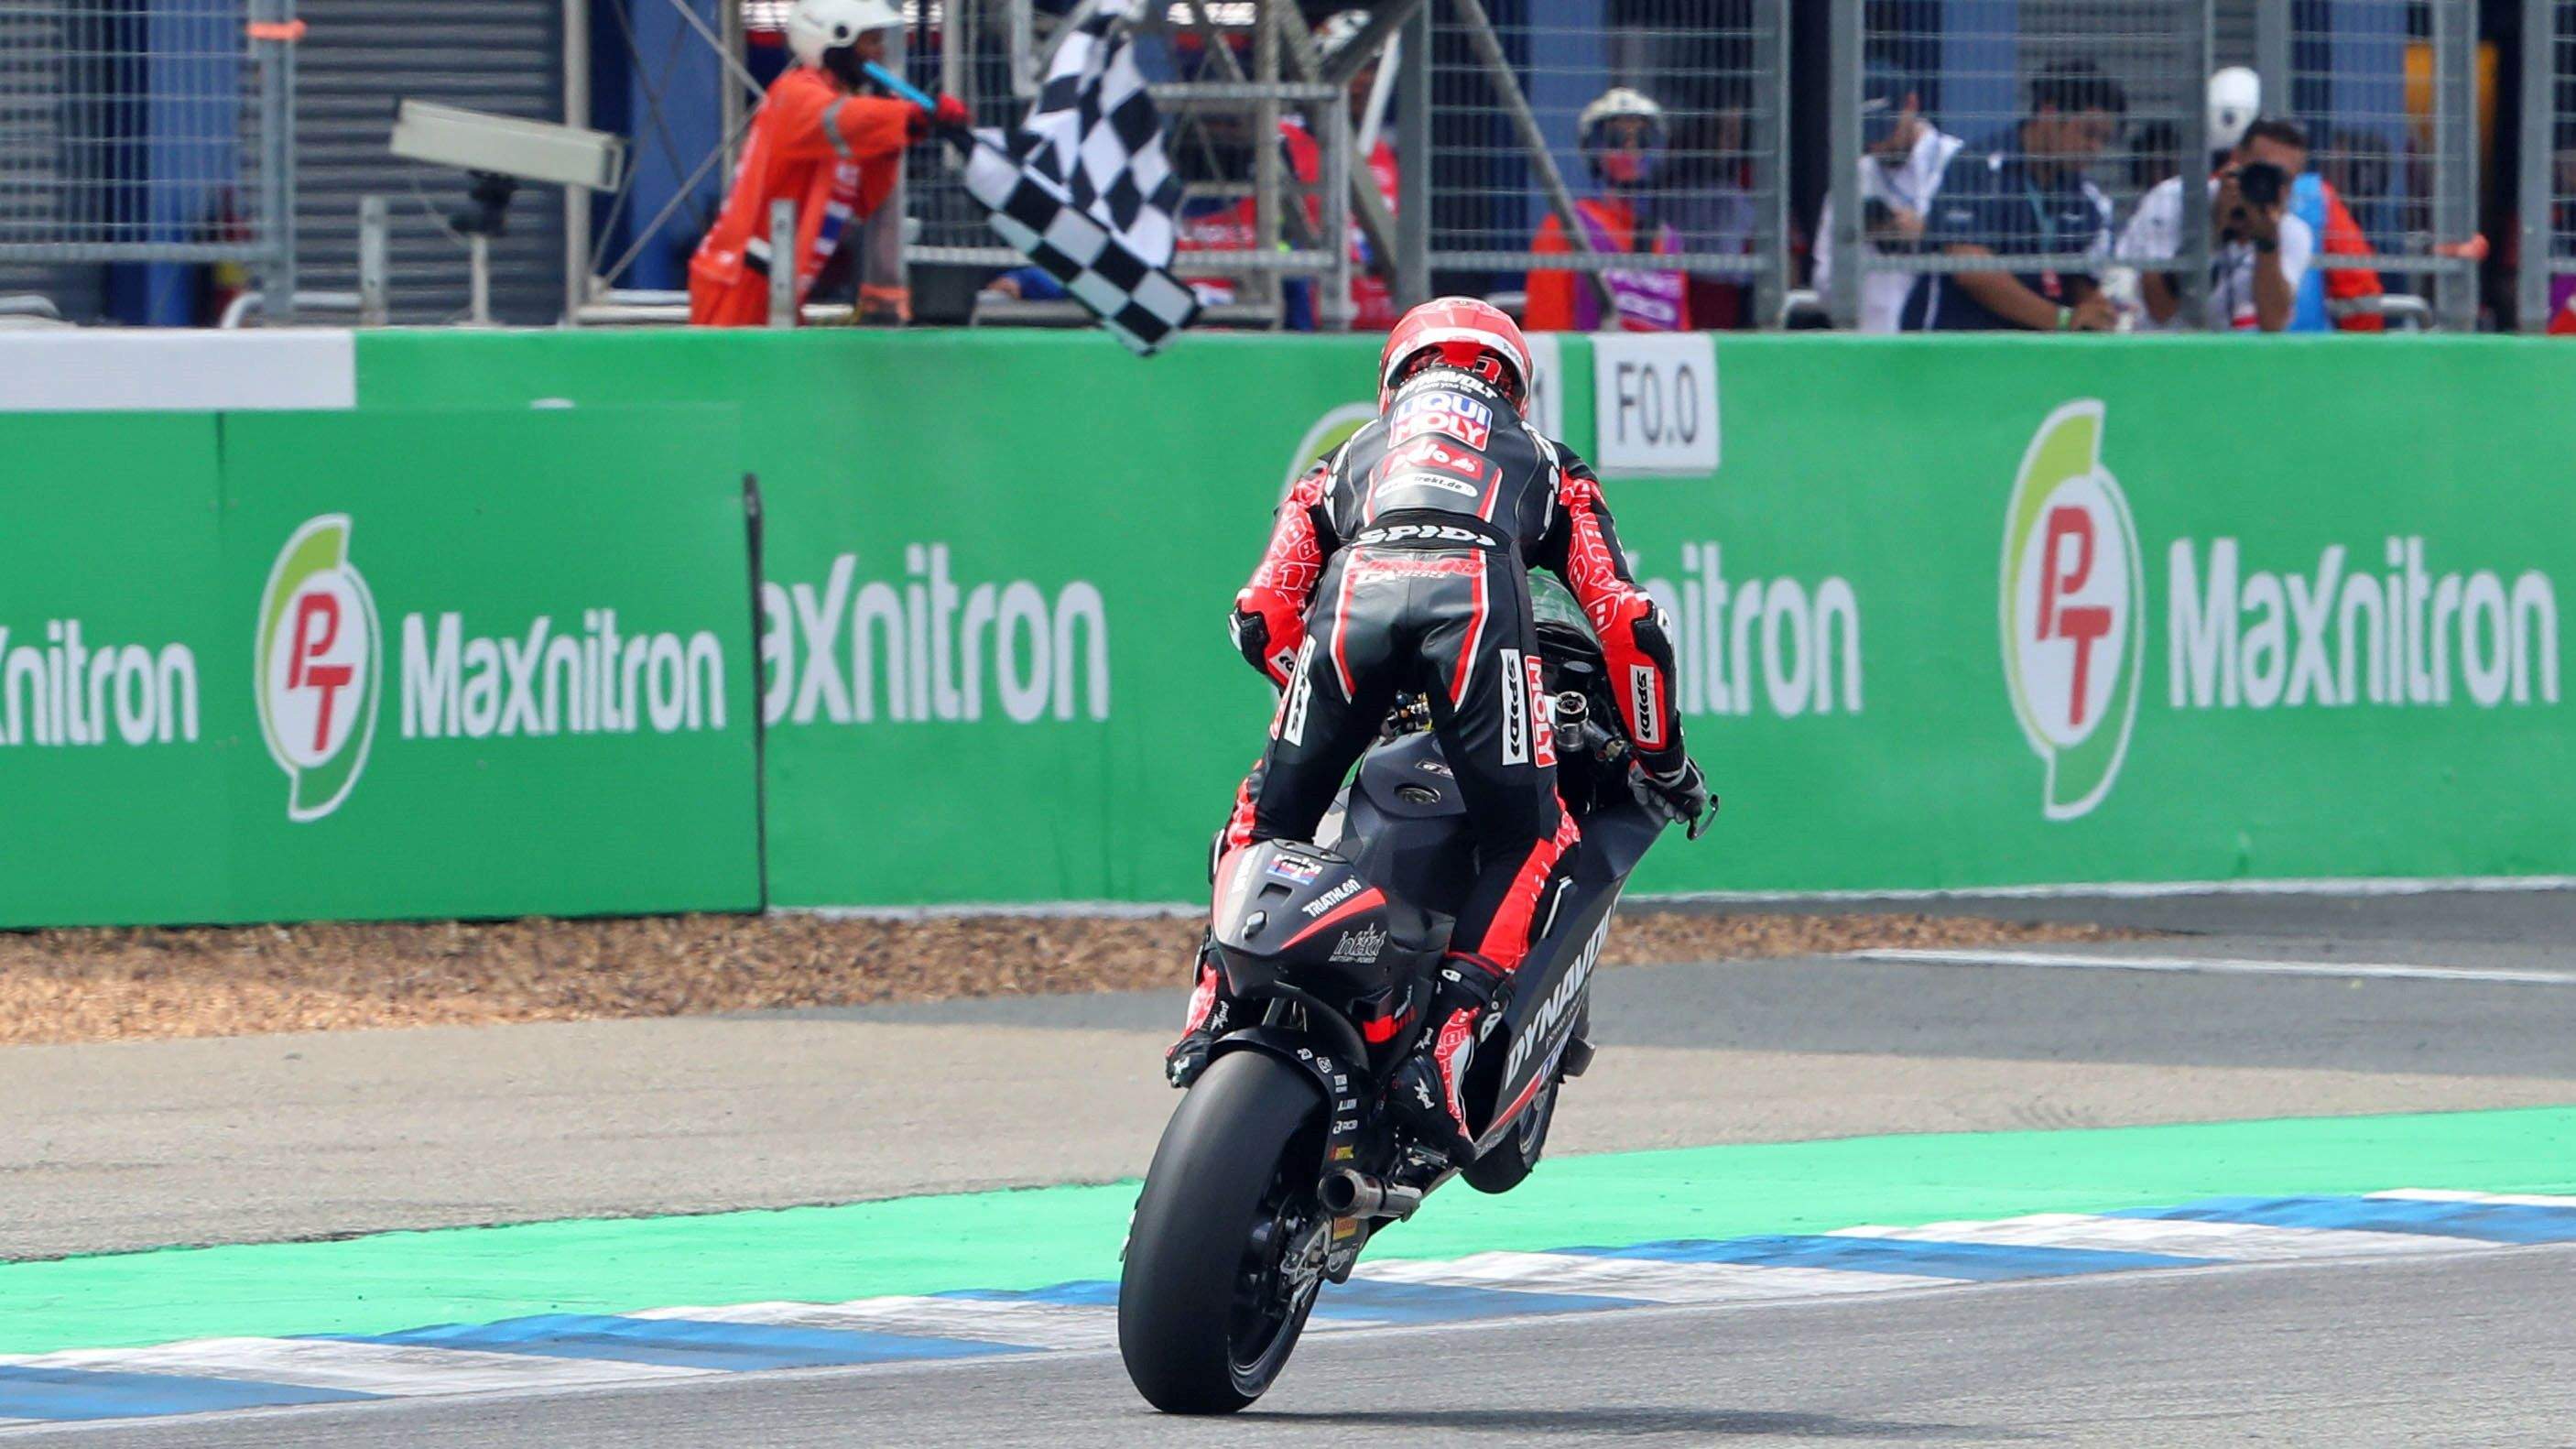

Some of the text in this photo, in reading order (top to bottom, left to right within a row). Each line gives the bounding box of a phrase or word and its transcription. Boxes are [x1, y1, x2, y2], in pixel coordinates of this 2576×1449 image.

[1394, 411, 1485, 447] MOLY
[1397, 394, 1488, 426] LIQUI
[1615, 361, 1698, 445] F0.0
[1352, 525, 1496, 547] SPIDI
[400, 608, 726, 738] Maxnitron
[761, 542, 1110, 725] axnitron
[1625, 540, 1862, 719] nitron
[2168, 536, 2560, 709] Maxnitron
[1506, 656, 1520, 757] SPIDI
[1527, 661, 1555, 764] MOLY
[1636, 670, 1651, 739] SPIDI
[1505, 903, 1613, 1091] DYNAVO
